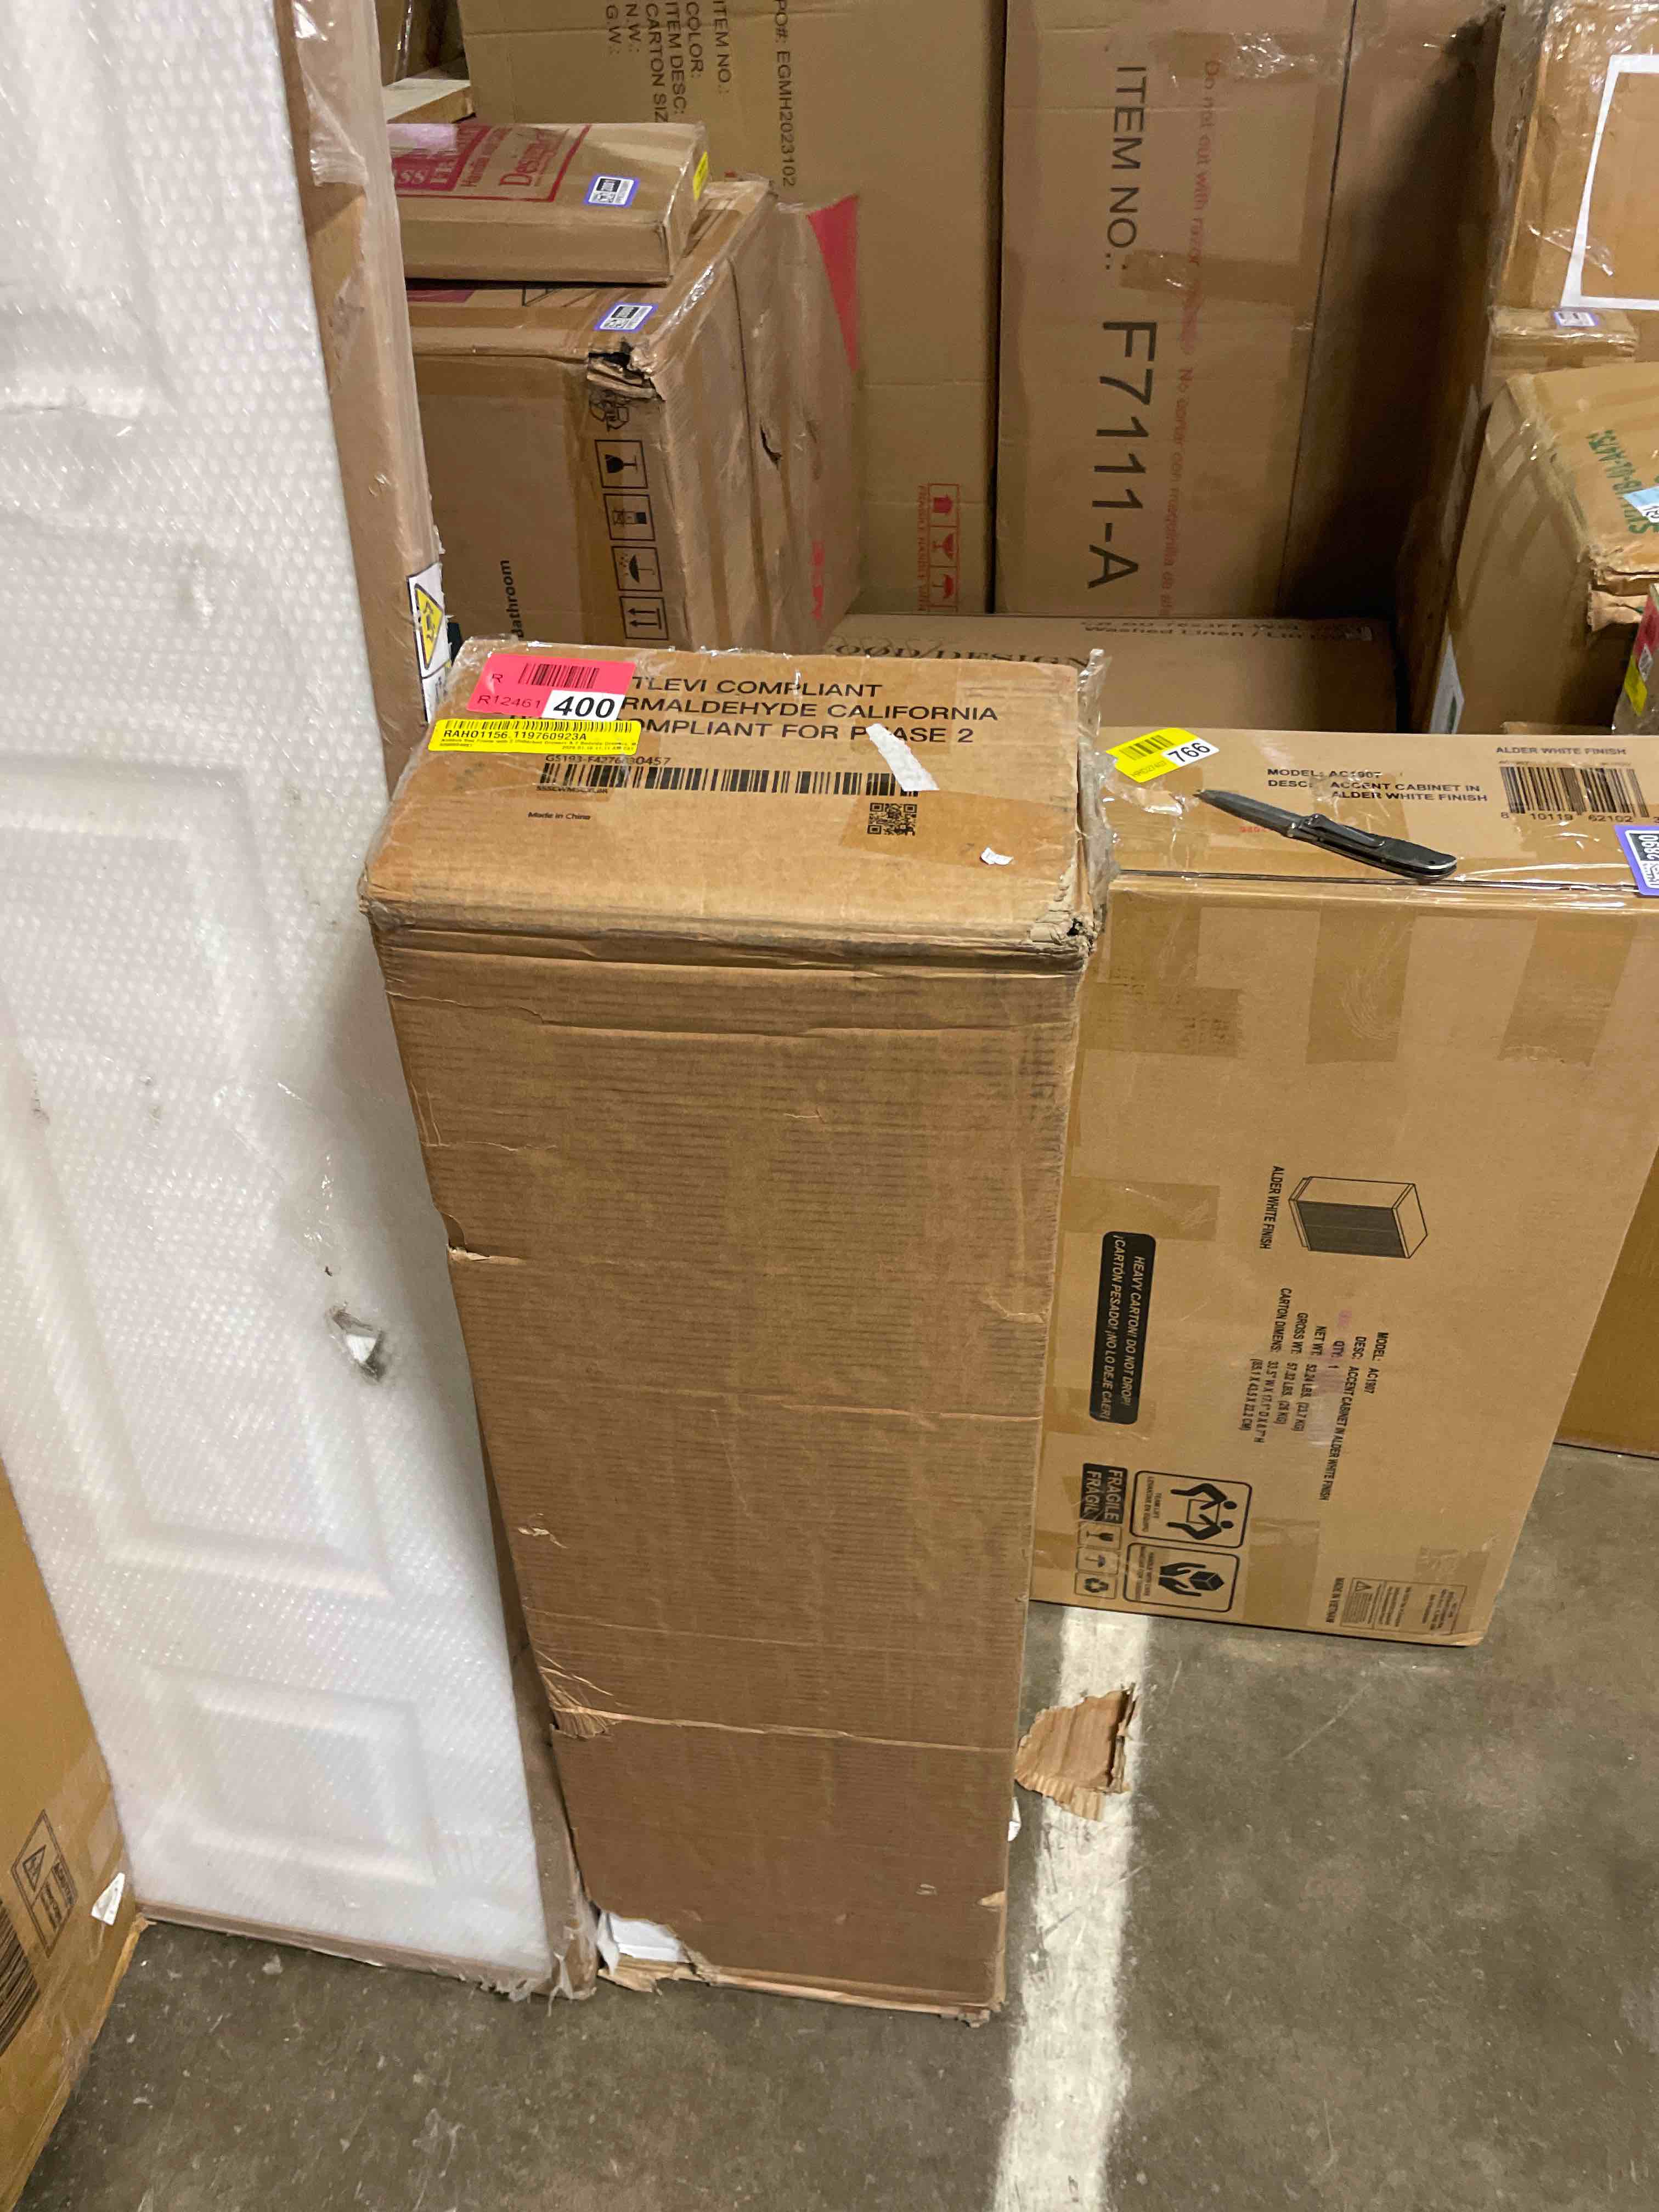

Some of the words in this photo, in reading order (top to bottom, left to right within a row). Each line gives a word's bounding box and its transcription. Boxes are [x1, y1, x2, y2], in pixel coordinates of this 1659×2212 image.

[626, 3, 641, 52] N.W.:
[665, 2, 682, 48] ITEM
[645, 4, 666, 87] CARTON
[686, 2, 703, 77] COLOR:
[670, 55, 687, 114] DESC:
[1205, 60, 1220, 90] Do
[653, 93, 669, 123] SIZ
[777, 50, 797, 187] EGMH2023102
[1110, 66, 1147, 170] ITEM
[1200, 95, 1216, 128] not
[1197, 136, 1211, 167] cut
[1194, 172, 1210, 211] with
[1105, 187, 1140, 270] NO.:
[1189, 218, 1204, 266] razor
[1178, 367, 1194, 393] No
[1087, 321, 1157, 589] F7111-A
[492, 674, 504, 684] R
[631, 676, 708, 694] TLEVI
[716, 679, 883, 698] COMPLIANT
[477, 695, 541, 709] R12461
[553, 696, 615, 718] 400
[620, 696, 818, 718] RMALDEHYDE
[823, 704, 998, 721] CALIFORNIA
[514, 731, 588, 741] 119760923A
[782, 725, 838, 739] FOR
[850, 726, 946, 743] PASE
[957, 728, 974, 743] 2
[1167, 742, 1211, 762] 766
[1267, 768, 1324, 777] MODEL:
[1330, 782, 1390, 791] ACCENT
[1395, 783, 1460, 792] CABINET
[1332, 791, 1382, 800] ALDER
[1386, 792, 1436, 800] WHITE
[1438, 794, 1487, 802] FINISH
[566, 812, 591, 821] China
[1588, 815, 1633, 823] 62102
[1268, 1165, 1285, 1194] ALDER
[1263, 1196, 1280, 1223] WHITE
[1259, 1223, 1276, 1250] FINISH
[1131, 1255, 1146, 1291] HEAVY
[1107, 1284, 1120, 1329] PESADO!
[1126, 1292, 1142, 1337] CARTON!
[1276, 1287, 1293, 1320] CARTON
[1293, 1312, 1309, 1340] GROSS
[1313, 1325, 1327, 1342] NET
[1104, 1350, 1116, 1363] LO
[1125, 1338, 1137, 1353] DO
[1330, 1340, 1345, 1358] QTY:
[1352, 1336, 1367, 1360] DESC:
[1372, 1331, 1389, 1362] MODEL:
[1102, 1365, 1115, 1389] DEJE
[1122, 1355, 1134, 1375] NOT
[1304, 1363, 1317, 1383] 52.24
[1341, 1366, 1359, 1396] ACCENT
[1363, 1367, 1380, 1395] AC1907
[1335, 1397, 1353, 1427] CABINET
[1328, 1435, 1344, 1458] ALDER
[1323, 1458, 1339, 1480] WHITE
[1105, 1469, 1124, 1520] FRAGILE
[1318, 1480, 1334, 1502] FINISH
